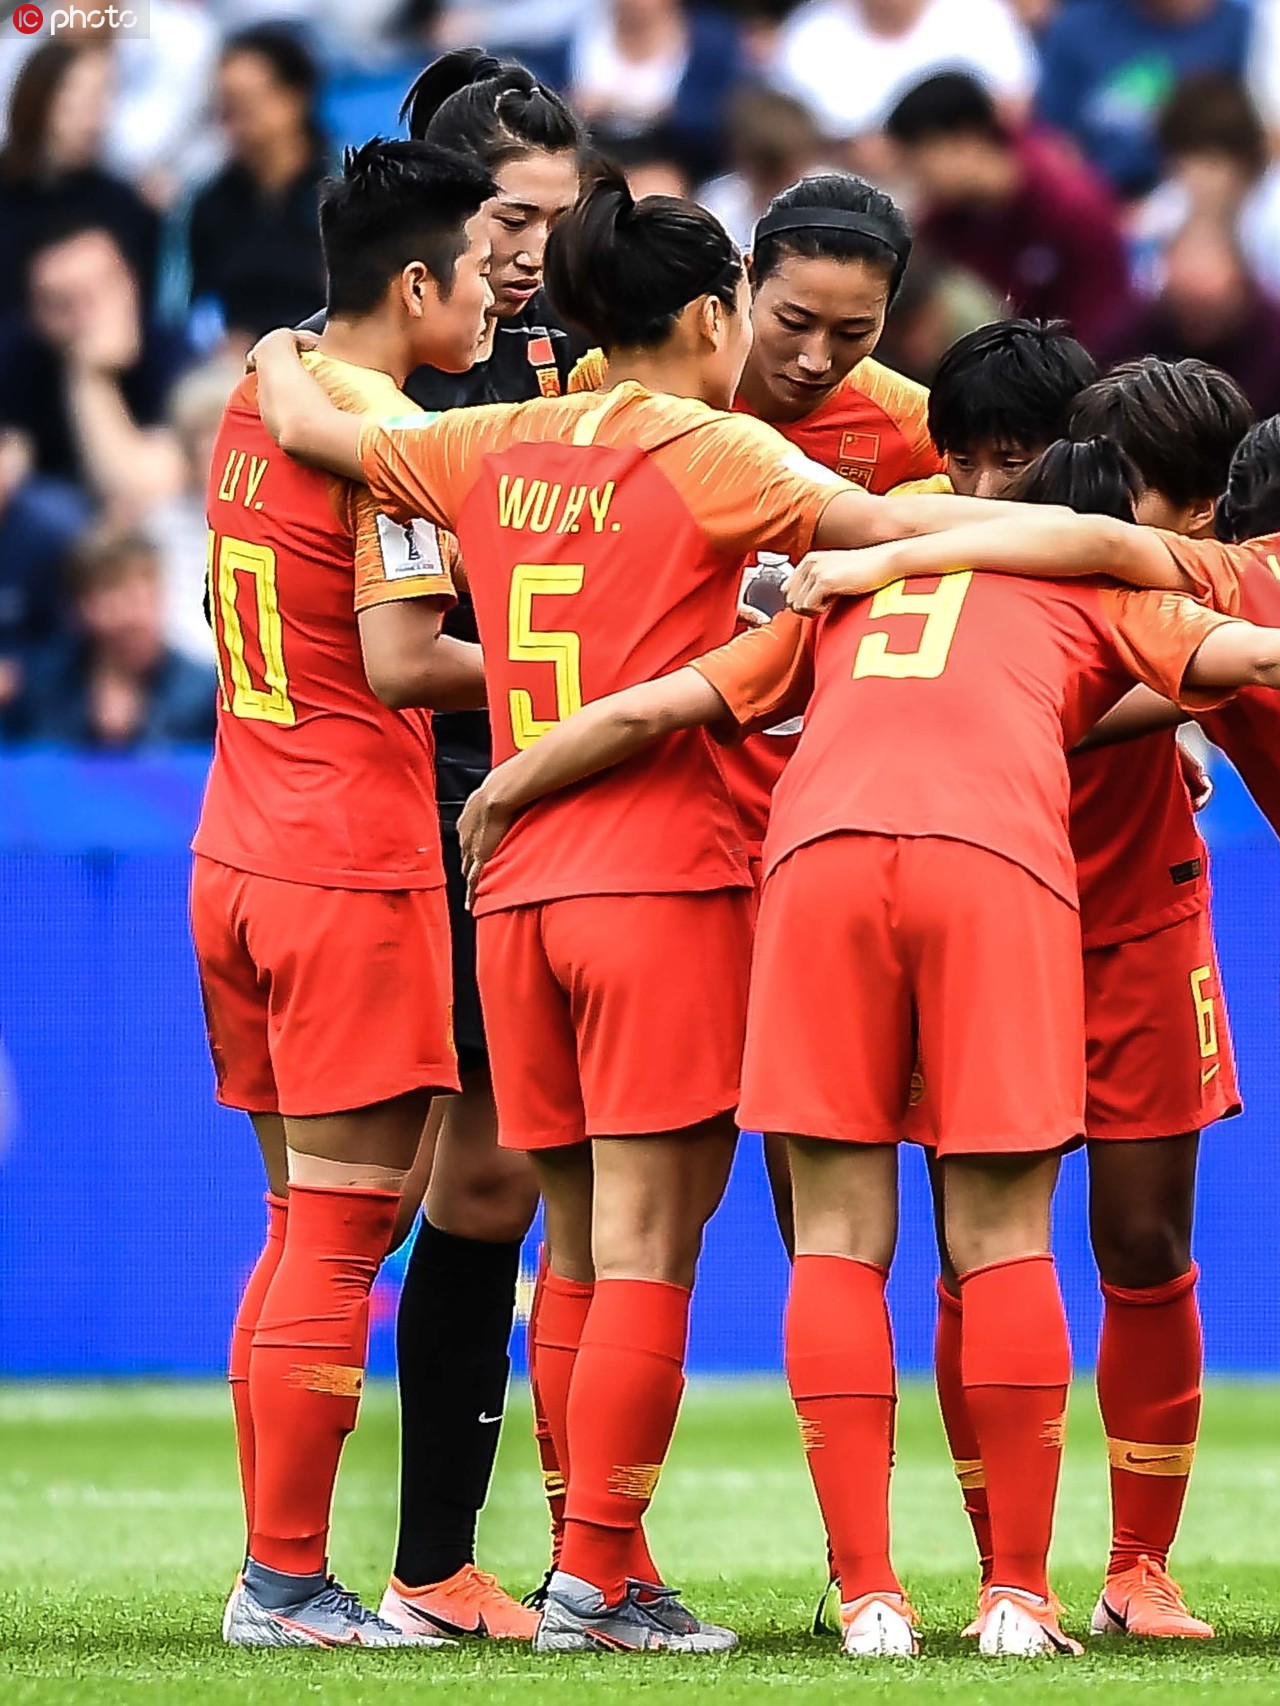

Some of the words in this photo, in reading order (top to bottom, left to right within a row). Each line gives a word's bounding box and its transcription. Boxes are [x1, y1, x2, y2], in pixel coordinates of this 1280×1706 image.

[498, 474, 562, 533] WU
[508, 564, 586, 751] 5
[851, 569, 975, 681] 9
[1190, 965, 1218, 1059] 6
